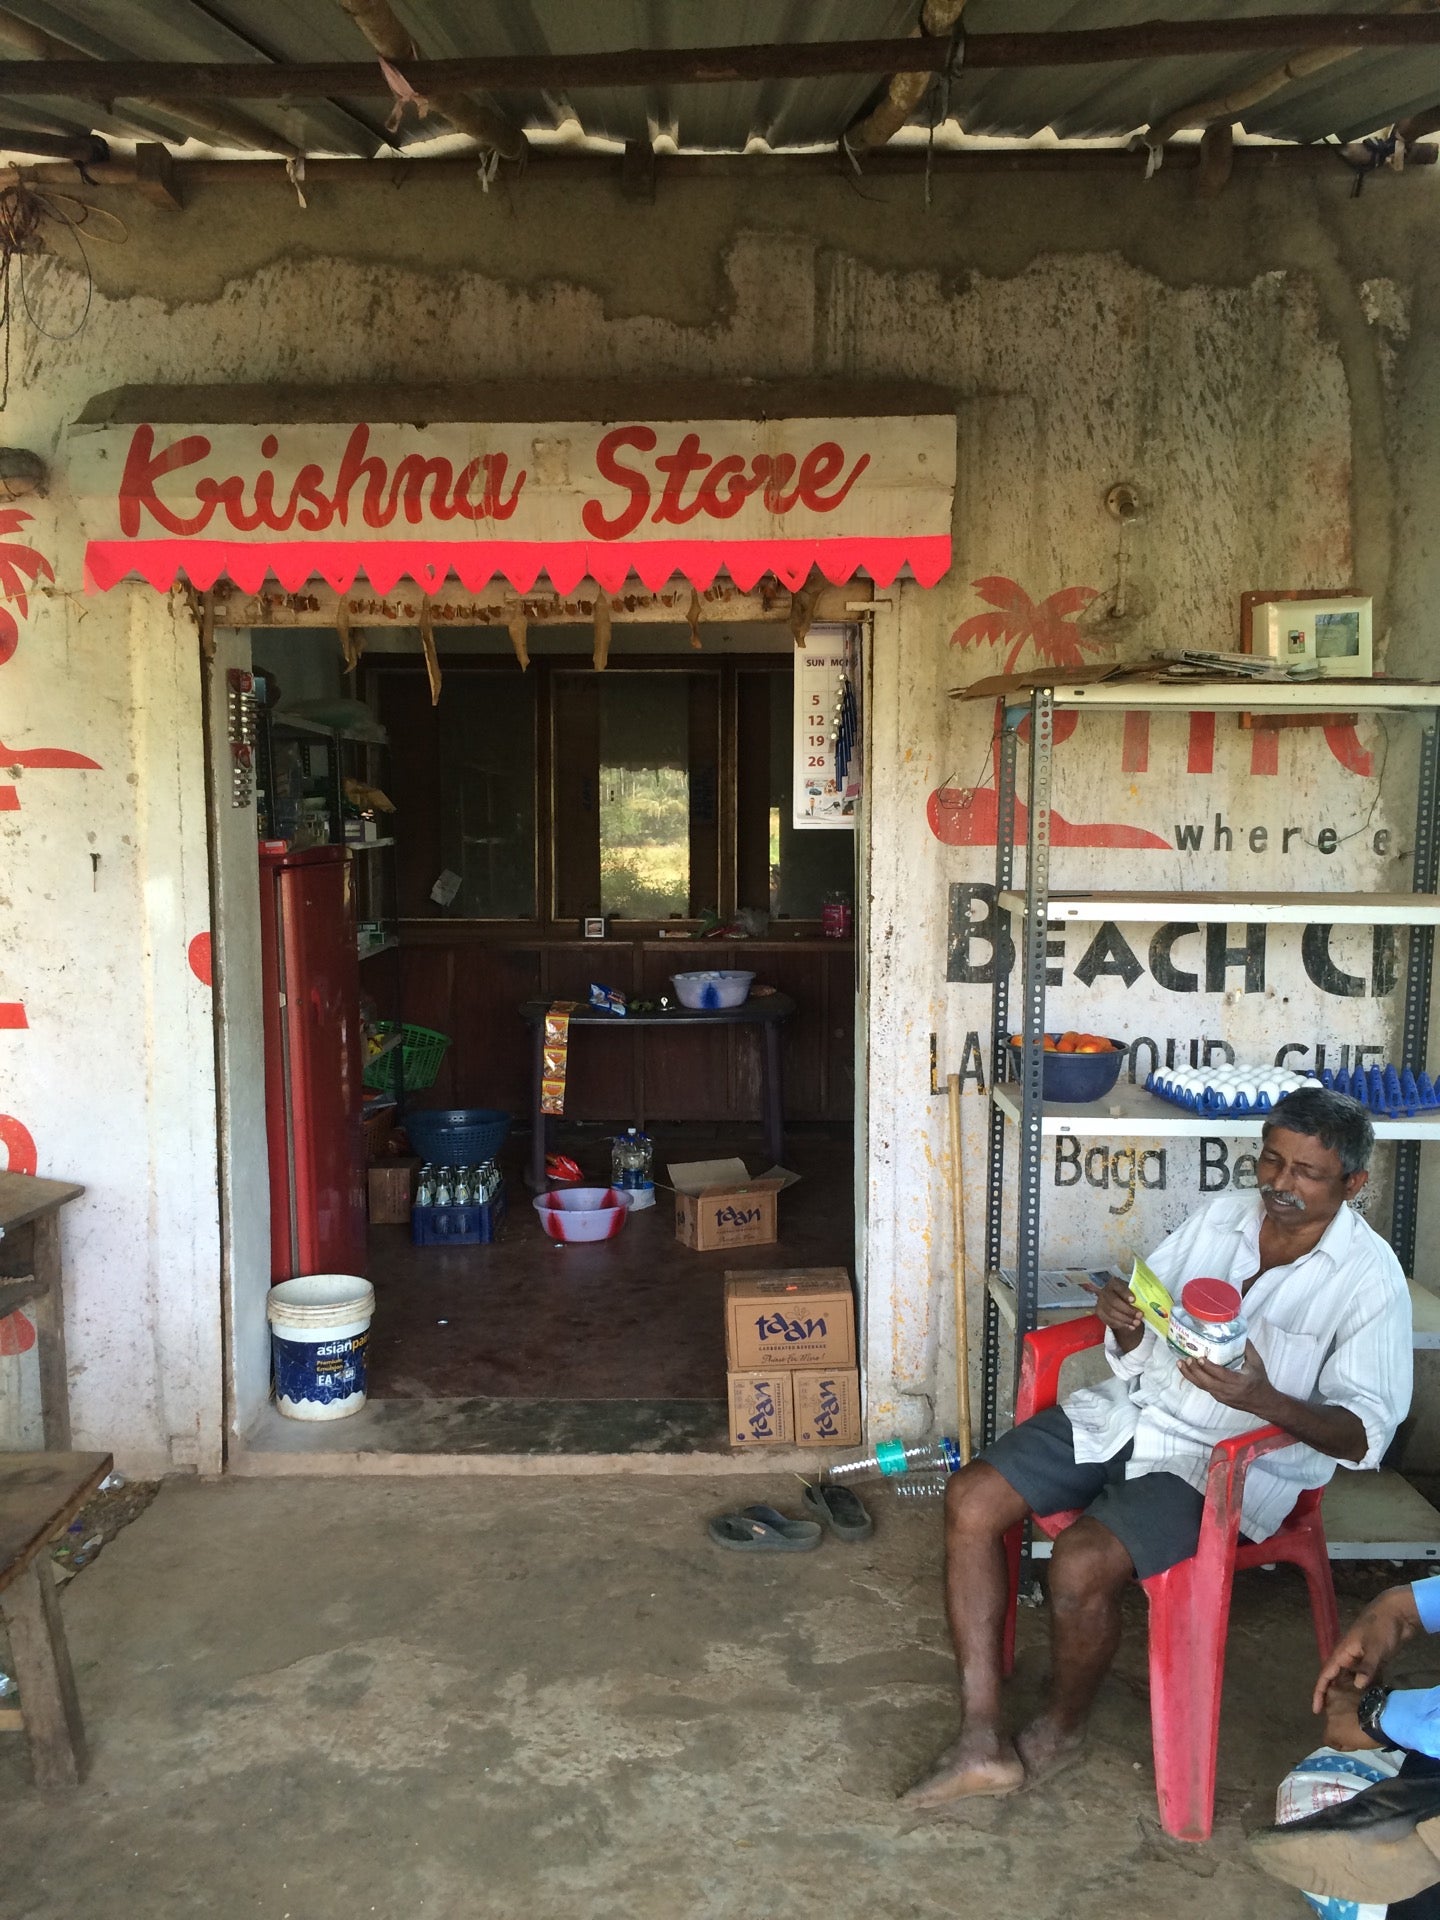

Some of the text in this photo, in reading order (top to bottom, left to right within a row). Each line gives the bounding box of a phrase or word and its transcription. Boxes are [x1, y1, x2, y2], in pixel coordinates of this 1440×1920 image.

[119, 423, 871, 540] Krishna Store
[806, 659, 825, 667] SUN
[812, 695, 820, 706] 5
[808, 715, 825, 726] 12
[808, 735, 825, 747] 19
[808, 755, 825, 767] 26
[1174, 813, 1338, 855] where
[1054, 1134, 1258, 1215] Baga Be
